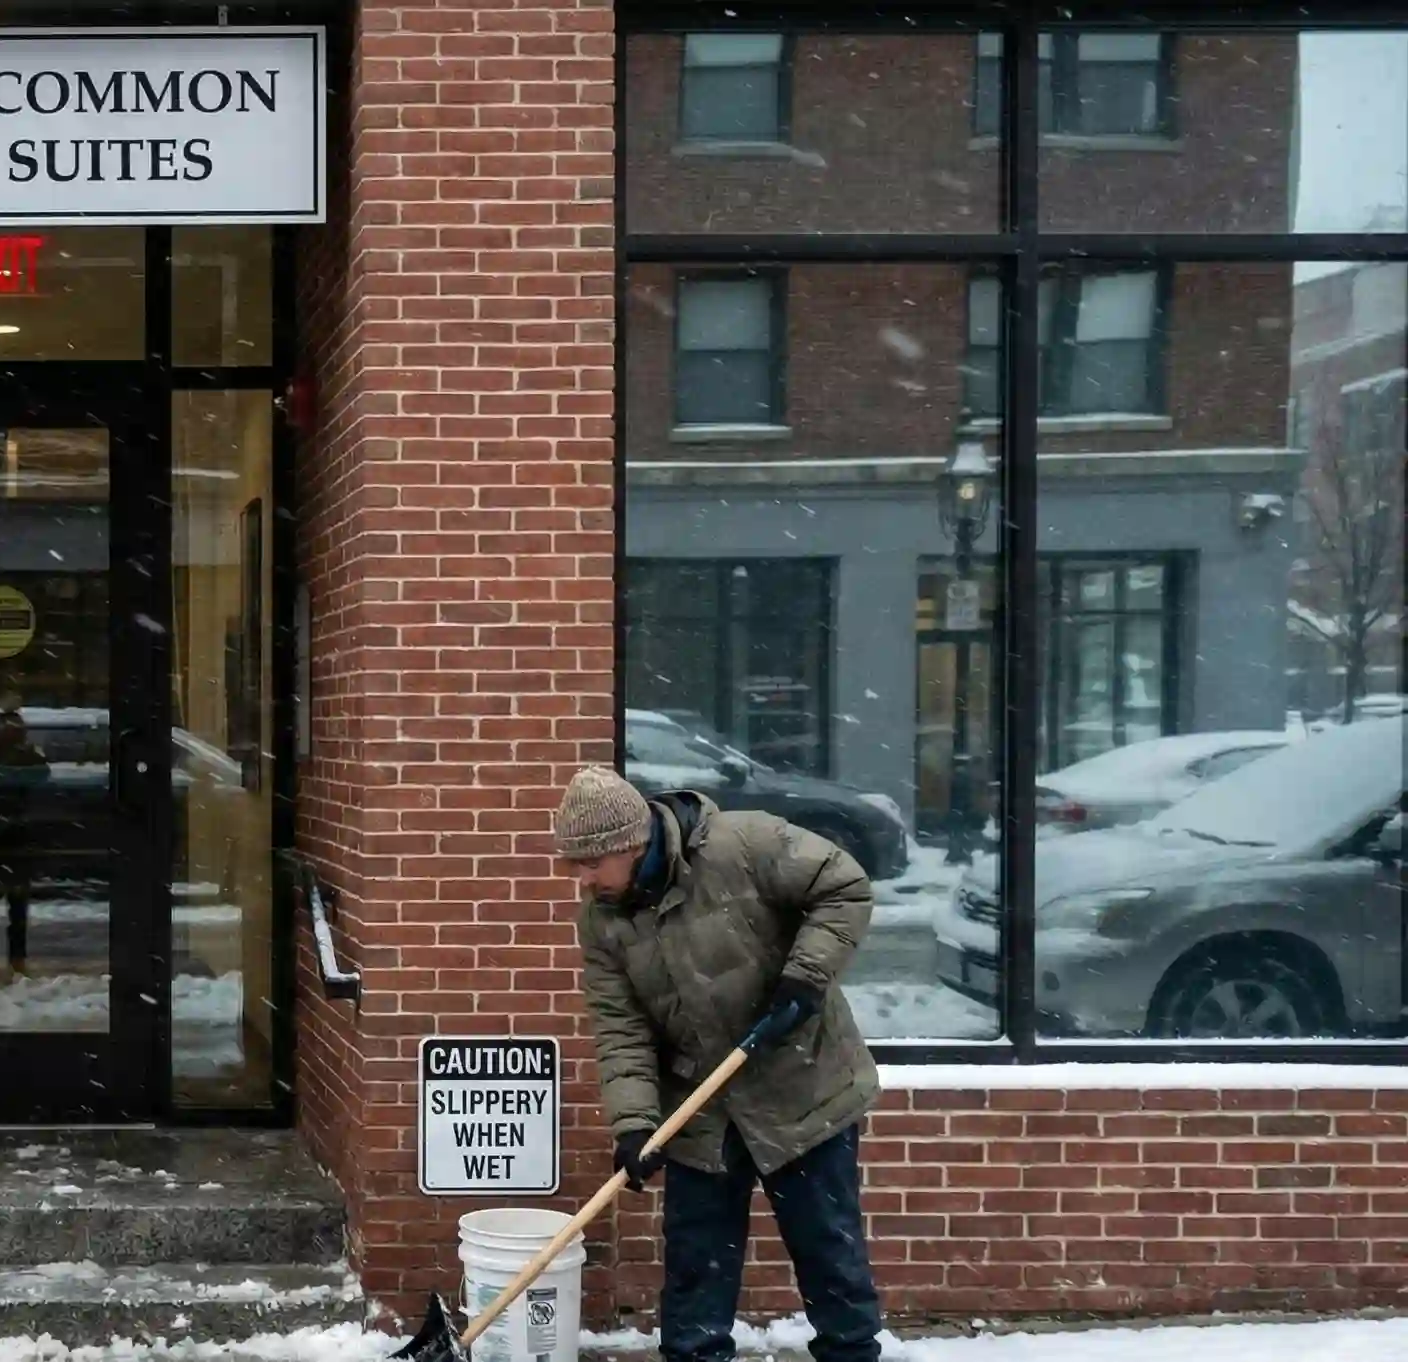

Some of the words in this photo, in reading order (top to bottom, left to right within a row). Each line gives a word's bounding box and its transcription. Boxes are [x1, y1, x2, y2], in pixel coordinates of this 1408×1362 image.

[8, 138, 214, 183] SUITES
[429, 1047, 551, 1075] CAUTION:
[431, 1089, 548, 1115] SLIPPERY
[452, 1122, 525, 1148] WHEN
[462, 1154, 516, 1180] WET
